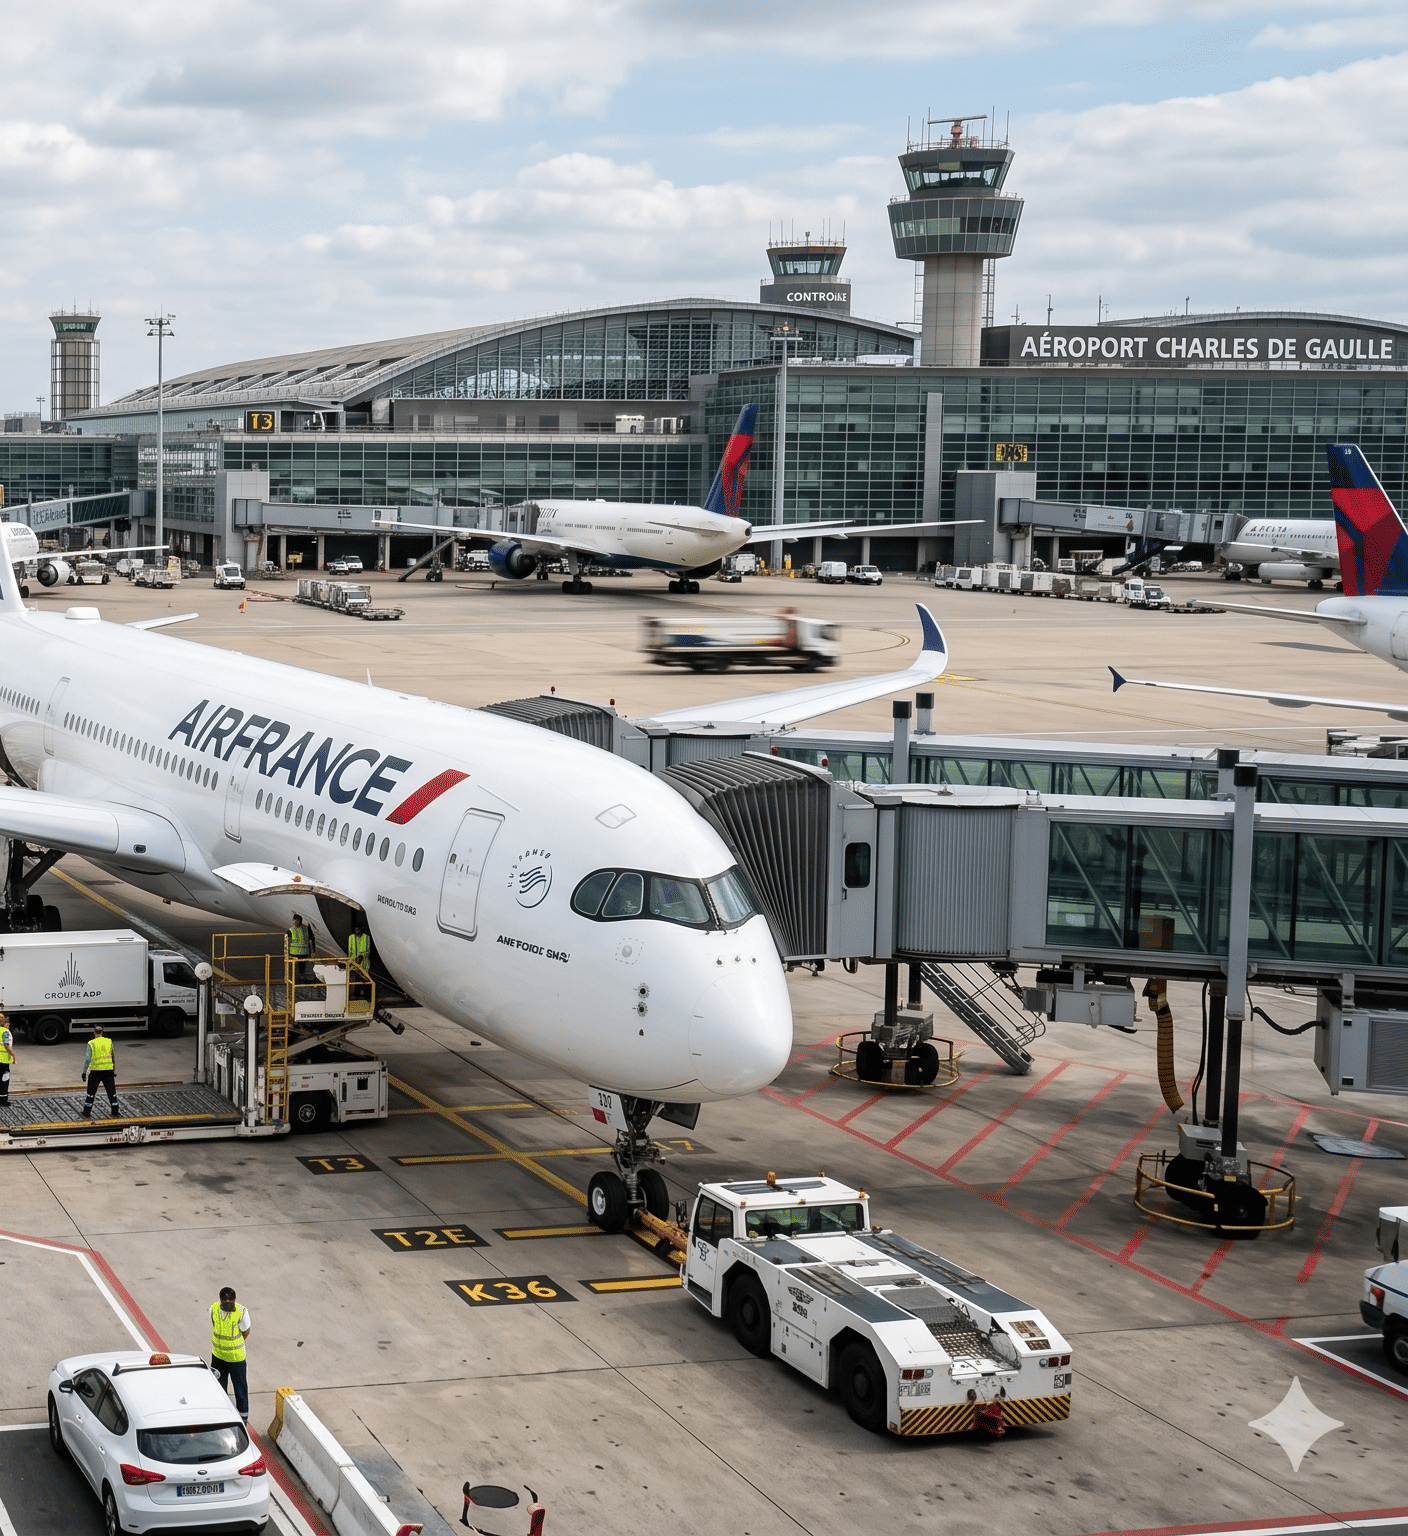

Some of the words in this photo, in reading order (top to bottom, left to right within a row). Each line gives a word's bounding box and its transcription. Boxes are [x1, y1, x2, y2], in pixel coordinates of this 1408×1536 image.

[1020, 331, 1148, 358] AÉROPORT
[1155, 337, 1259, 359] CHARLES
[1268, 338, 1296, 359] DE
[1305, 338, 1393, 360] GAULLE
[82, 990, 102, 998] ADP
[308, 1157, 365, 1171] T3
[384, 1228, 476, 1247] T2E
[458, 1280, 558, 1302] K36
